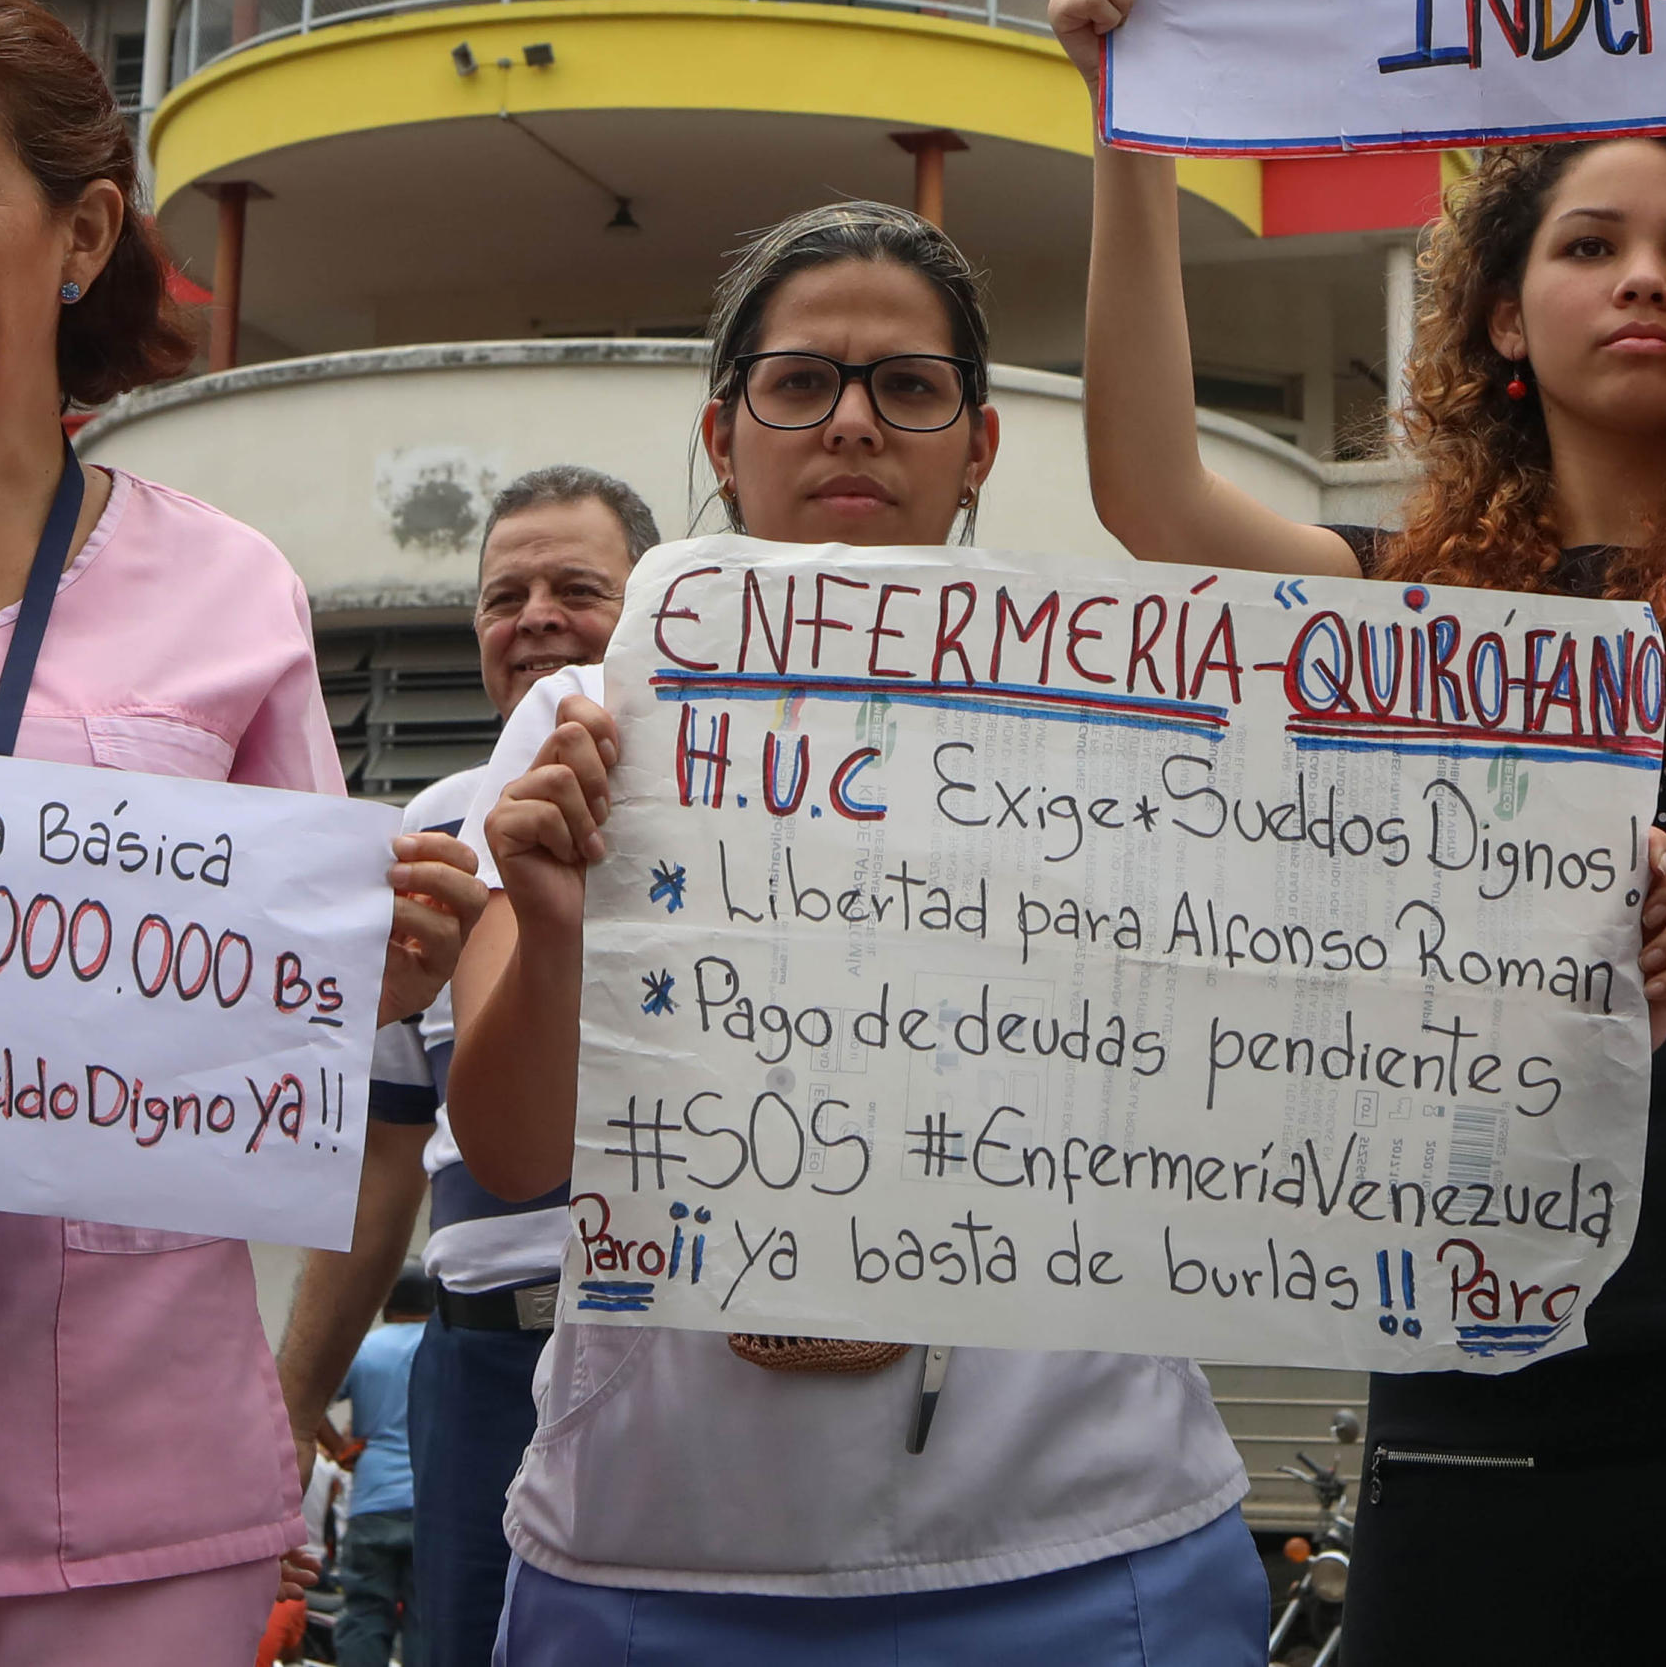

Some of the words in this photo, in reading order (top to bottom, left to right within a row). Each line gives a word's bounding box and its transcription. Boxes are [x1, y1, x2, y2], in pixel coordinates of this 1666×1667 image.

[39, 800, 233, 887] Básica
[1422, 779, 1641, 909] Dignos!
[274, 951, 343, 1013] Bs
[719, 840, 988, 940] Libertad
[1017, 888, 1141, 964] para
[1162, 890, 1389, 976] Alfonso
[1395, 899, 1614, 1014] Roman
[694, 956, 832, 1063] Pago
[853, 982, 937, 1052] de
[953, 984, 1165, 1079] deudas
[1207, 1016, 1562, 1118] pendientes
[605, 1090, 872, 1196] #SOS
[907, 1105, 1614, 1249] #EnfermeríaVenezuela
[851, 1209, 1019, 1284] basta
[1046, 1218, 1123, 1284] de
[1438, 1238, 1582, 1325] Paro
